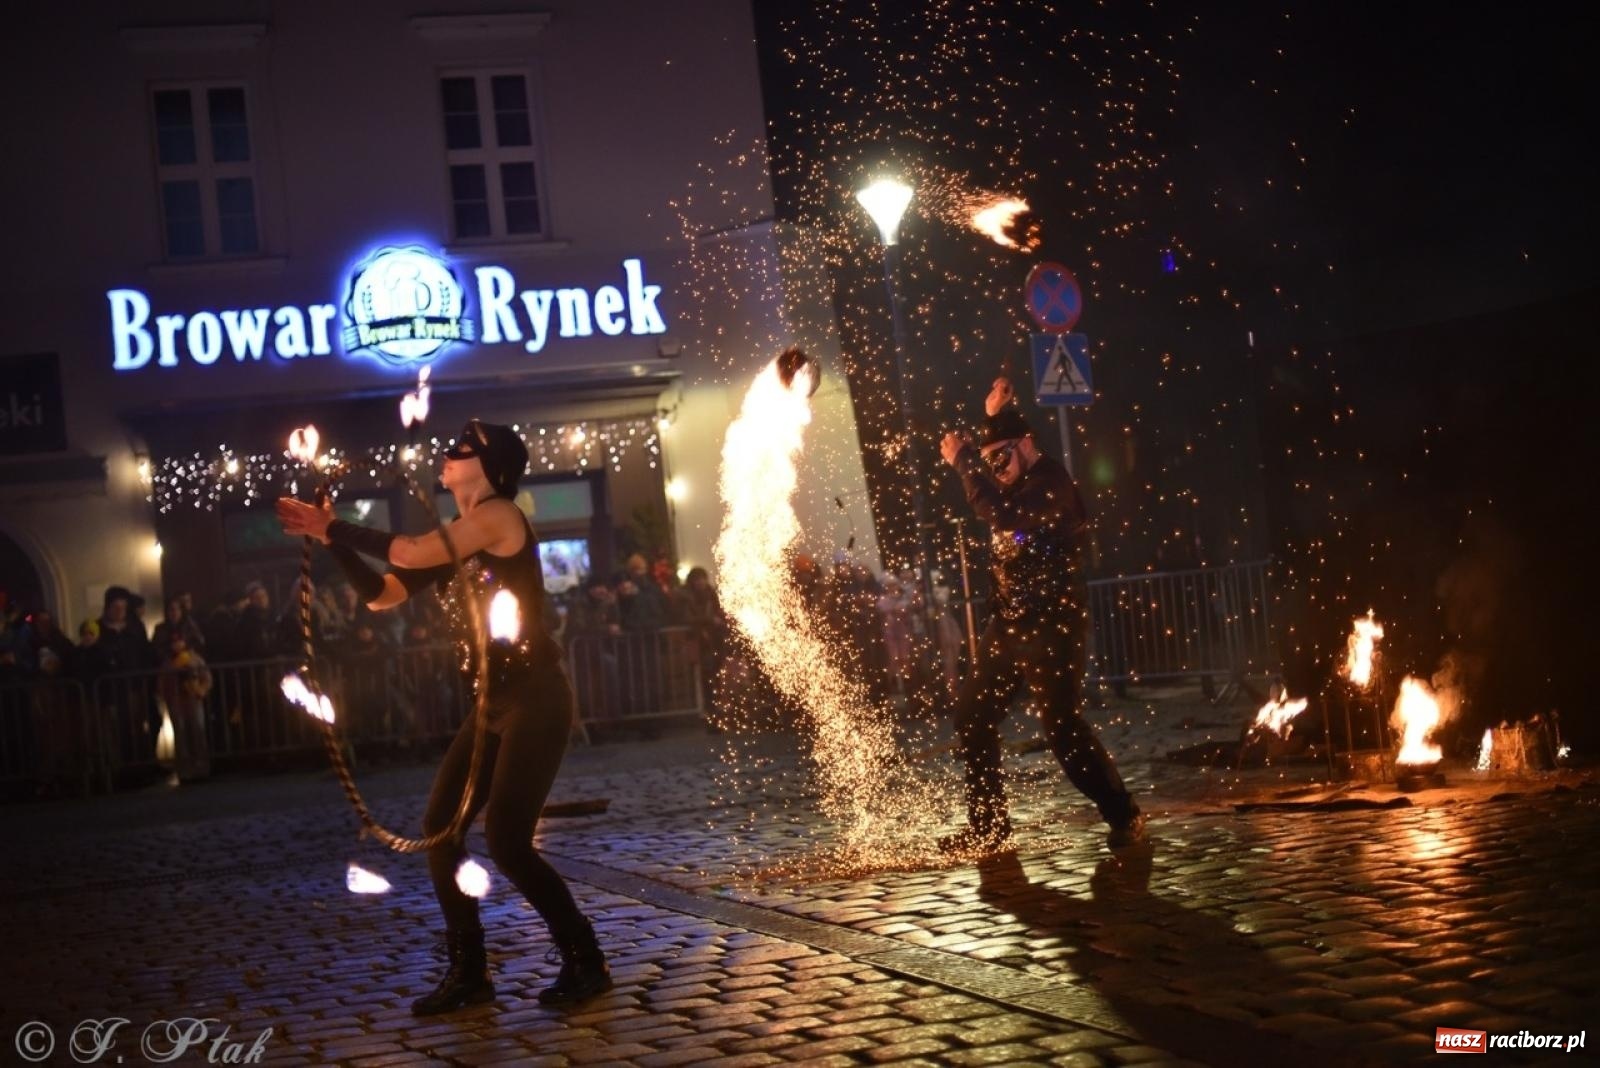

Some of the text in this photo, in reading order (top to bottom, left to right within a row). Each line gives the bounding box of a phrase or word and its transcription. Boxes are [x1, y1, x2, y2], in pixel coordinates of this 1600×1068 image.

[107, 259, 666, 370] Browar Rynek
[358, 317, 460, 345] Browar Rynek
